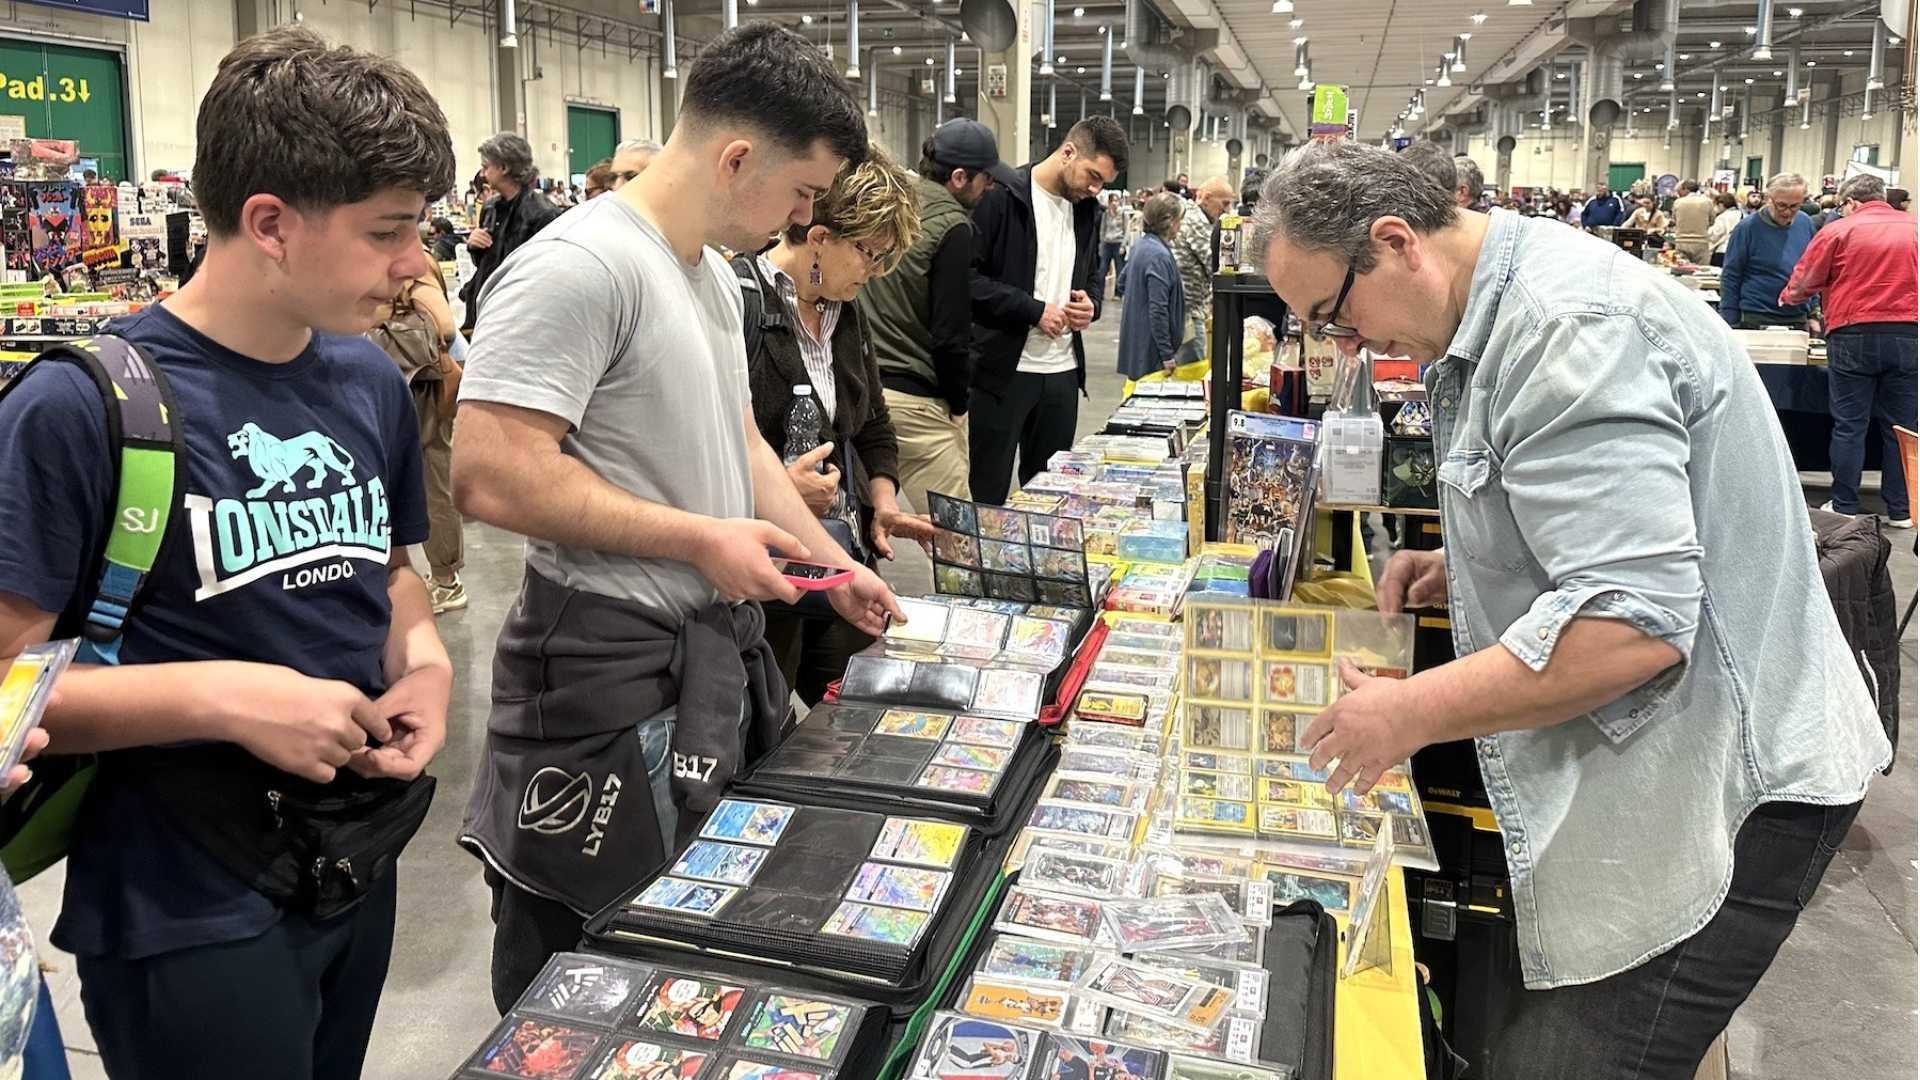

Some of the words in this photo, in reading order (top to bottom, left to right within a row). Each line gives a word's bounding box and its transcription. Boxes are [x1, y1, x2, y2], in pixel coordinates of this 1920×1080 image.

[120, 506, 159, 533] SJ
[184, 475, 392, 602] LONSDALE
[283, 560, 356, 590] LONDO
[673, 752, 719, 783] B17
[581, 773, 623, 857] LYB17
